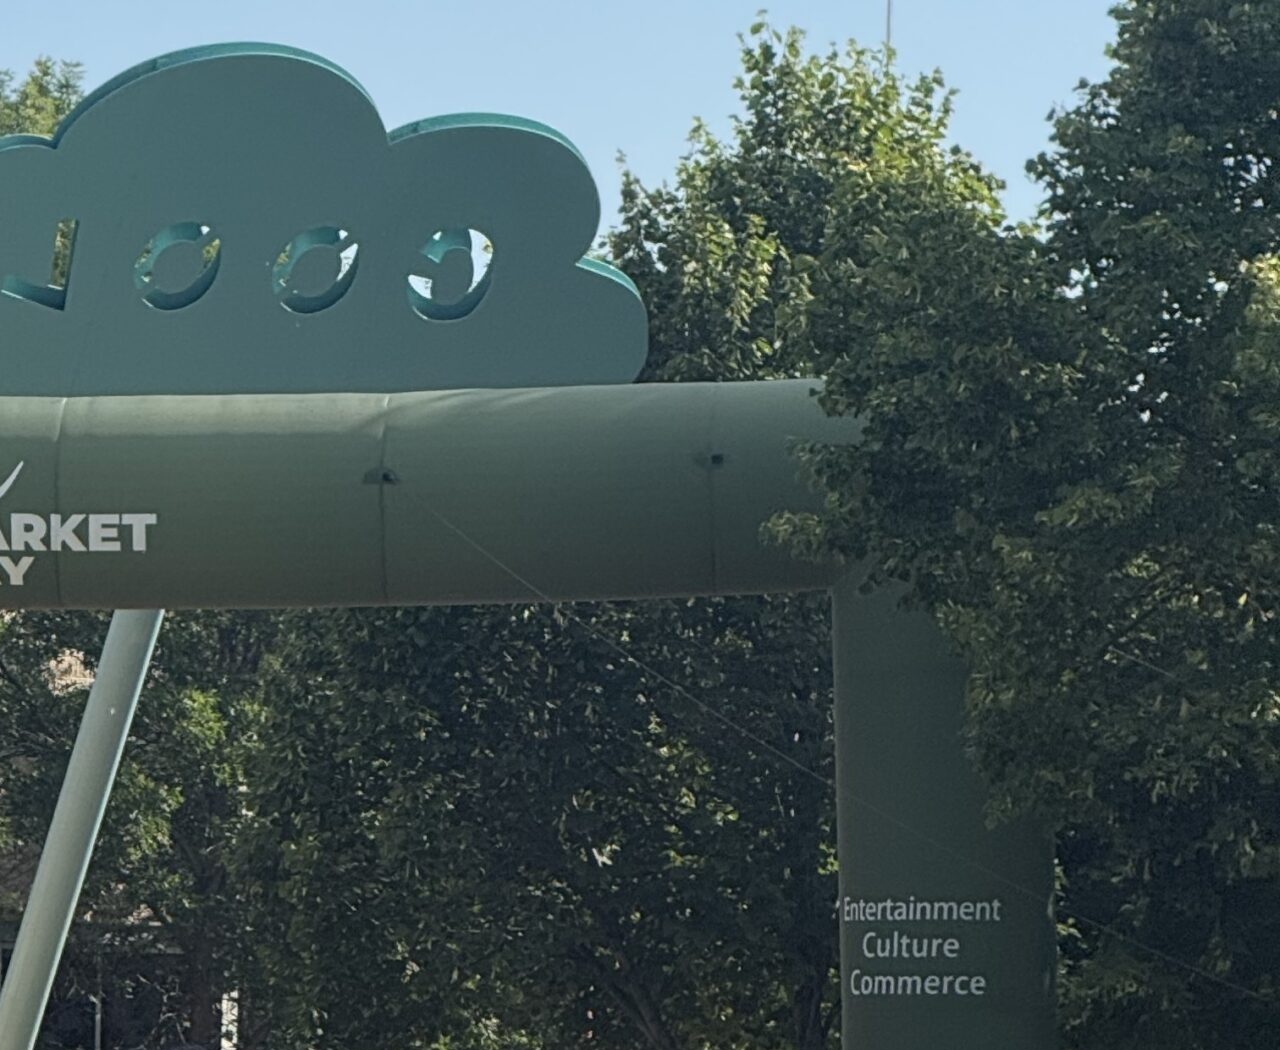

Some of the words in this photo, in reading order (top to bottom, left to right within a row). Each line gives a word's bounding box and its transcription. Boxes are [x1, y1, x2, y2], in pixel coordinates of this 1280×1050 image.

[842, 895, 1001, 922] Entertainment
[862, 931, 960, 958] Culture
[850, 969, 987, 996] Commerce
